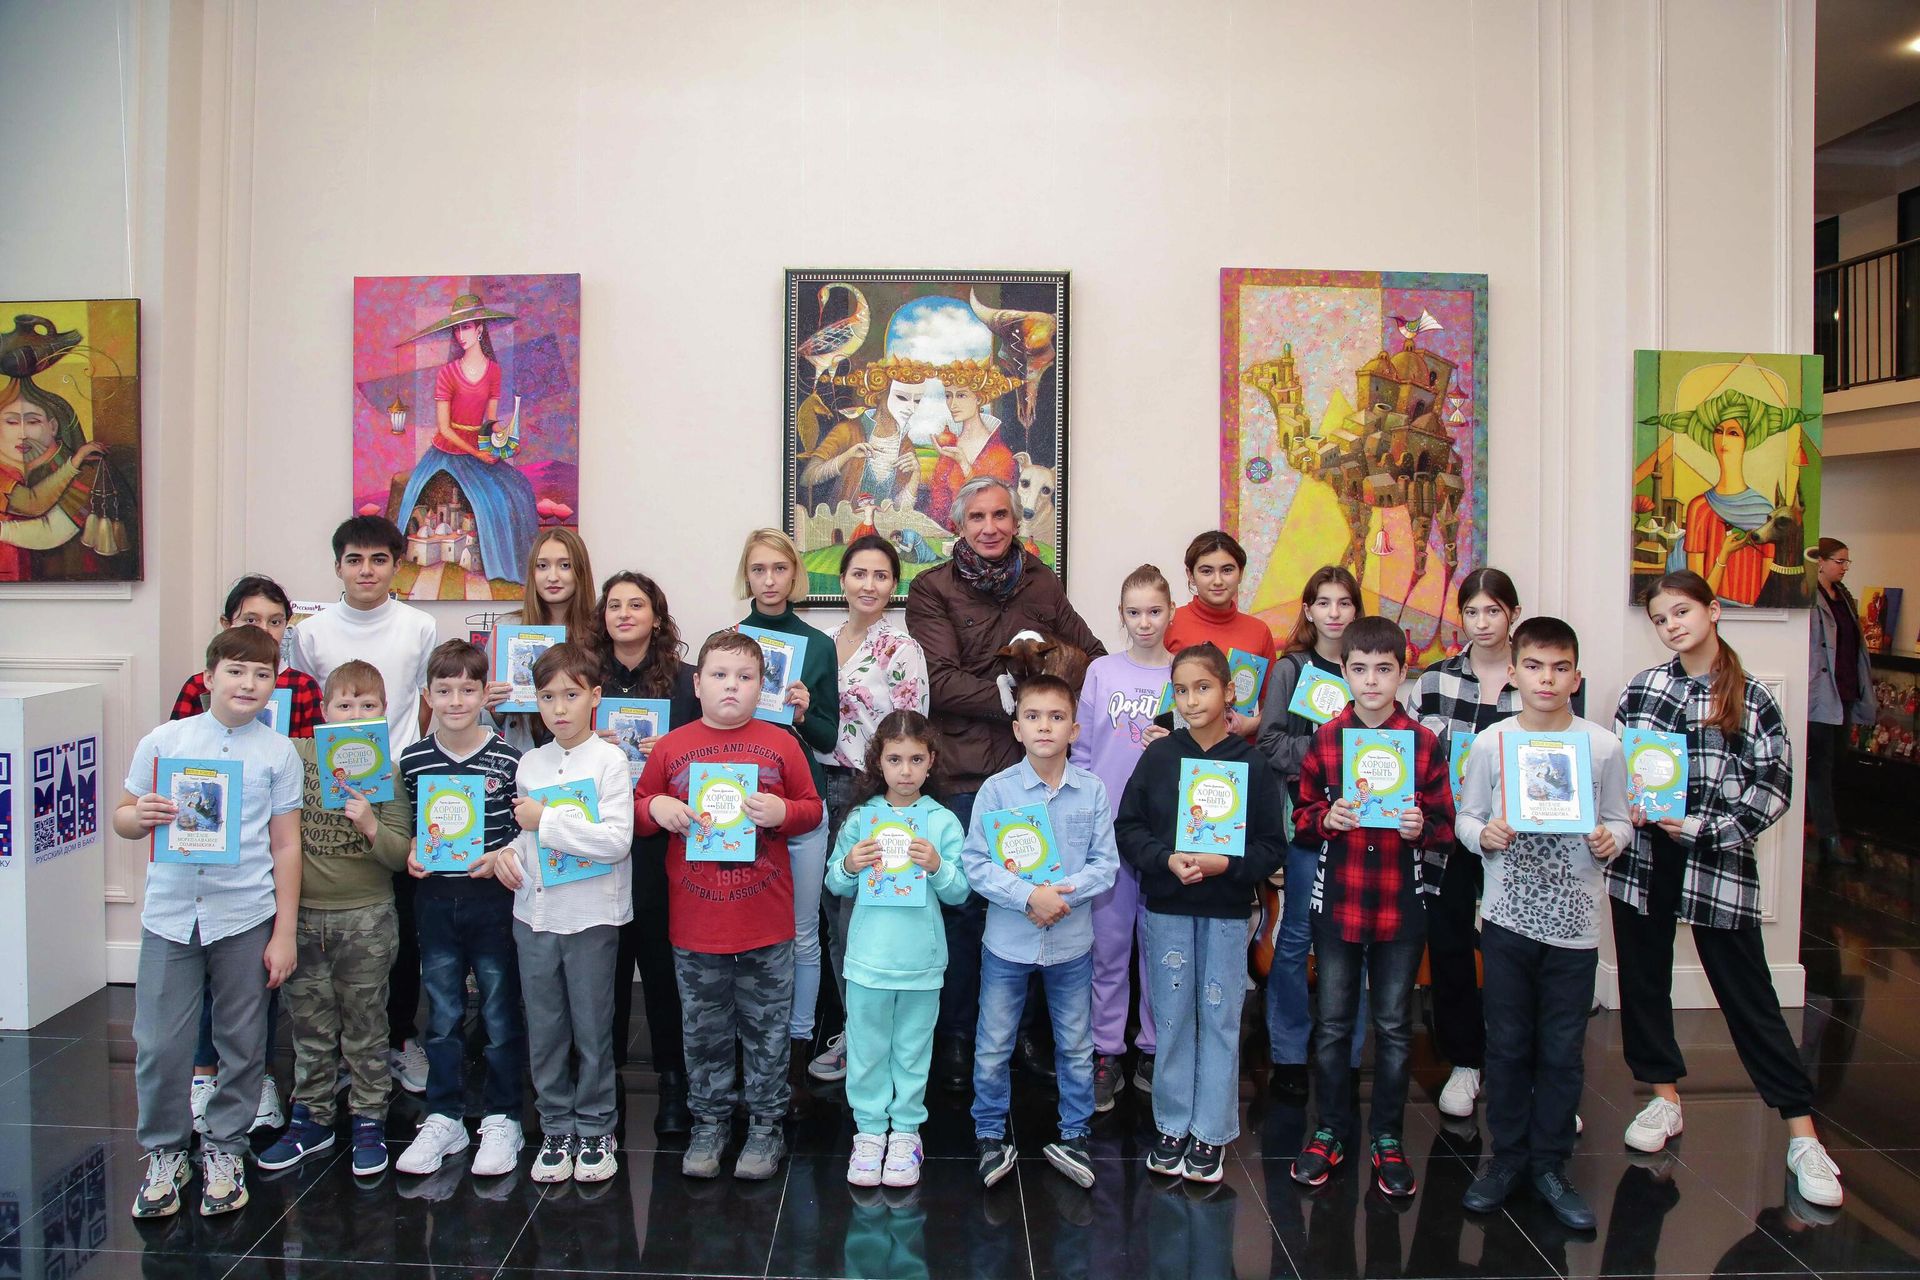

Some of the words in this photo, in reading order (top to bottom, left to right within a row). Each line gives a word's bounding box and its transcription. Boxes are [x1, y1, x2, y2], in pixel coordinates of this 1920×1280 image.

[722, 743, 745, 753] AND
[336, 750, 373, 759] ХОРОШО
[347, 757, 369, 765] БЫТЬ
[1361, 760, 1397, 769] ХОРОШО
[1371, 768, 1393, 778] БЫТЬ
[705, 793, 740, 802] ХОРОШО
[1197, 788, 1231, 798] ХОРОШО
[715, 801, 736, 810] БЫТЬ
[1206, 796, 1227, 806] БЫТЬ
[433, 805, 467, 814] ХОРОШО
[442, 813, 463, 822] БЫТЬ
[1004, 836, 1037, 849] ХОРОШО
[35, 847, 63, 865] РУССКИЙ
[63, 843, 77, 855] ДОМ
[82, 836, 96, 848] БАКУ
[886, 846, 906, 855] БЫТЬ
[1015, 845, 1035, 855] БЫТЬ
[716, 867, 751, 887] 1965
[681, 876, 725, 902] FOOTBALL
[728, 868, 783, 902] ASSOCIATION
